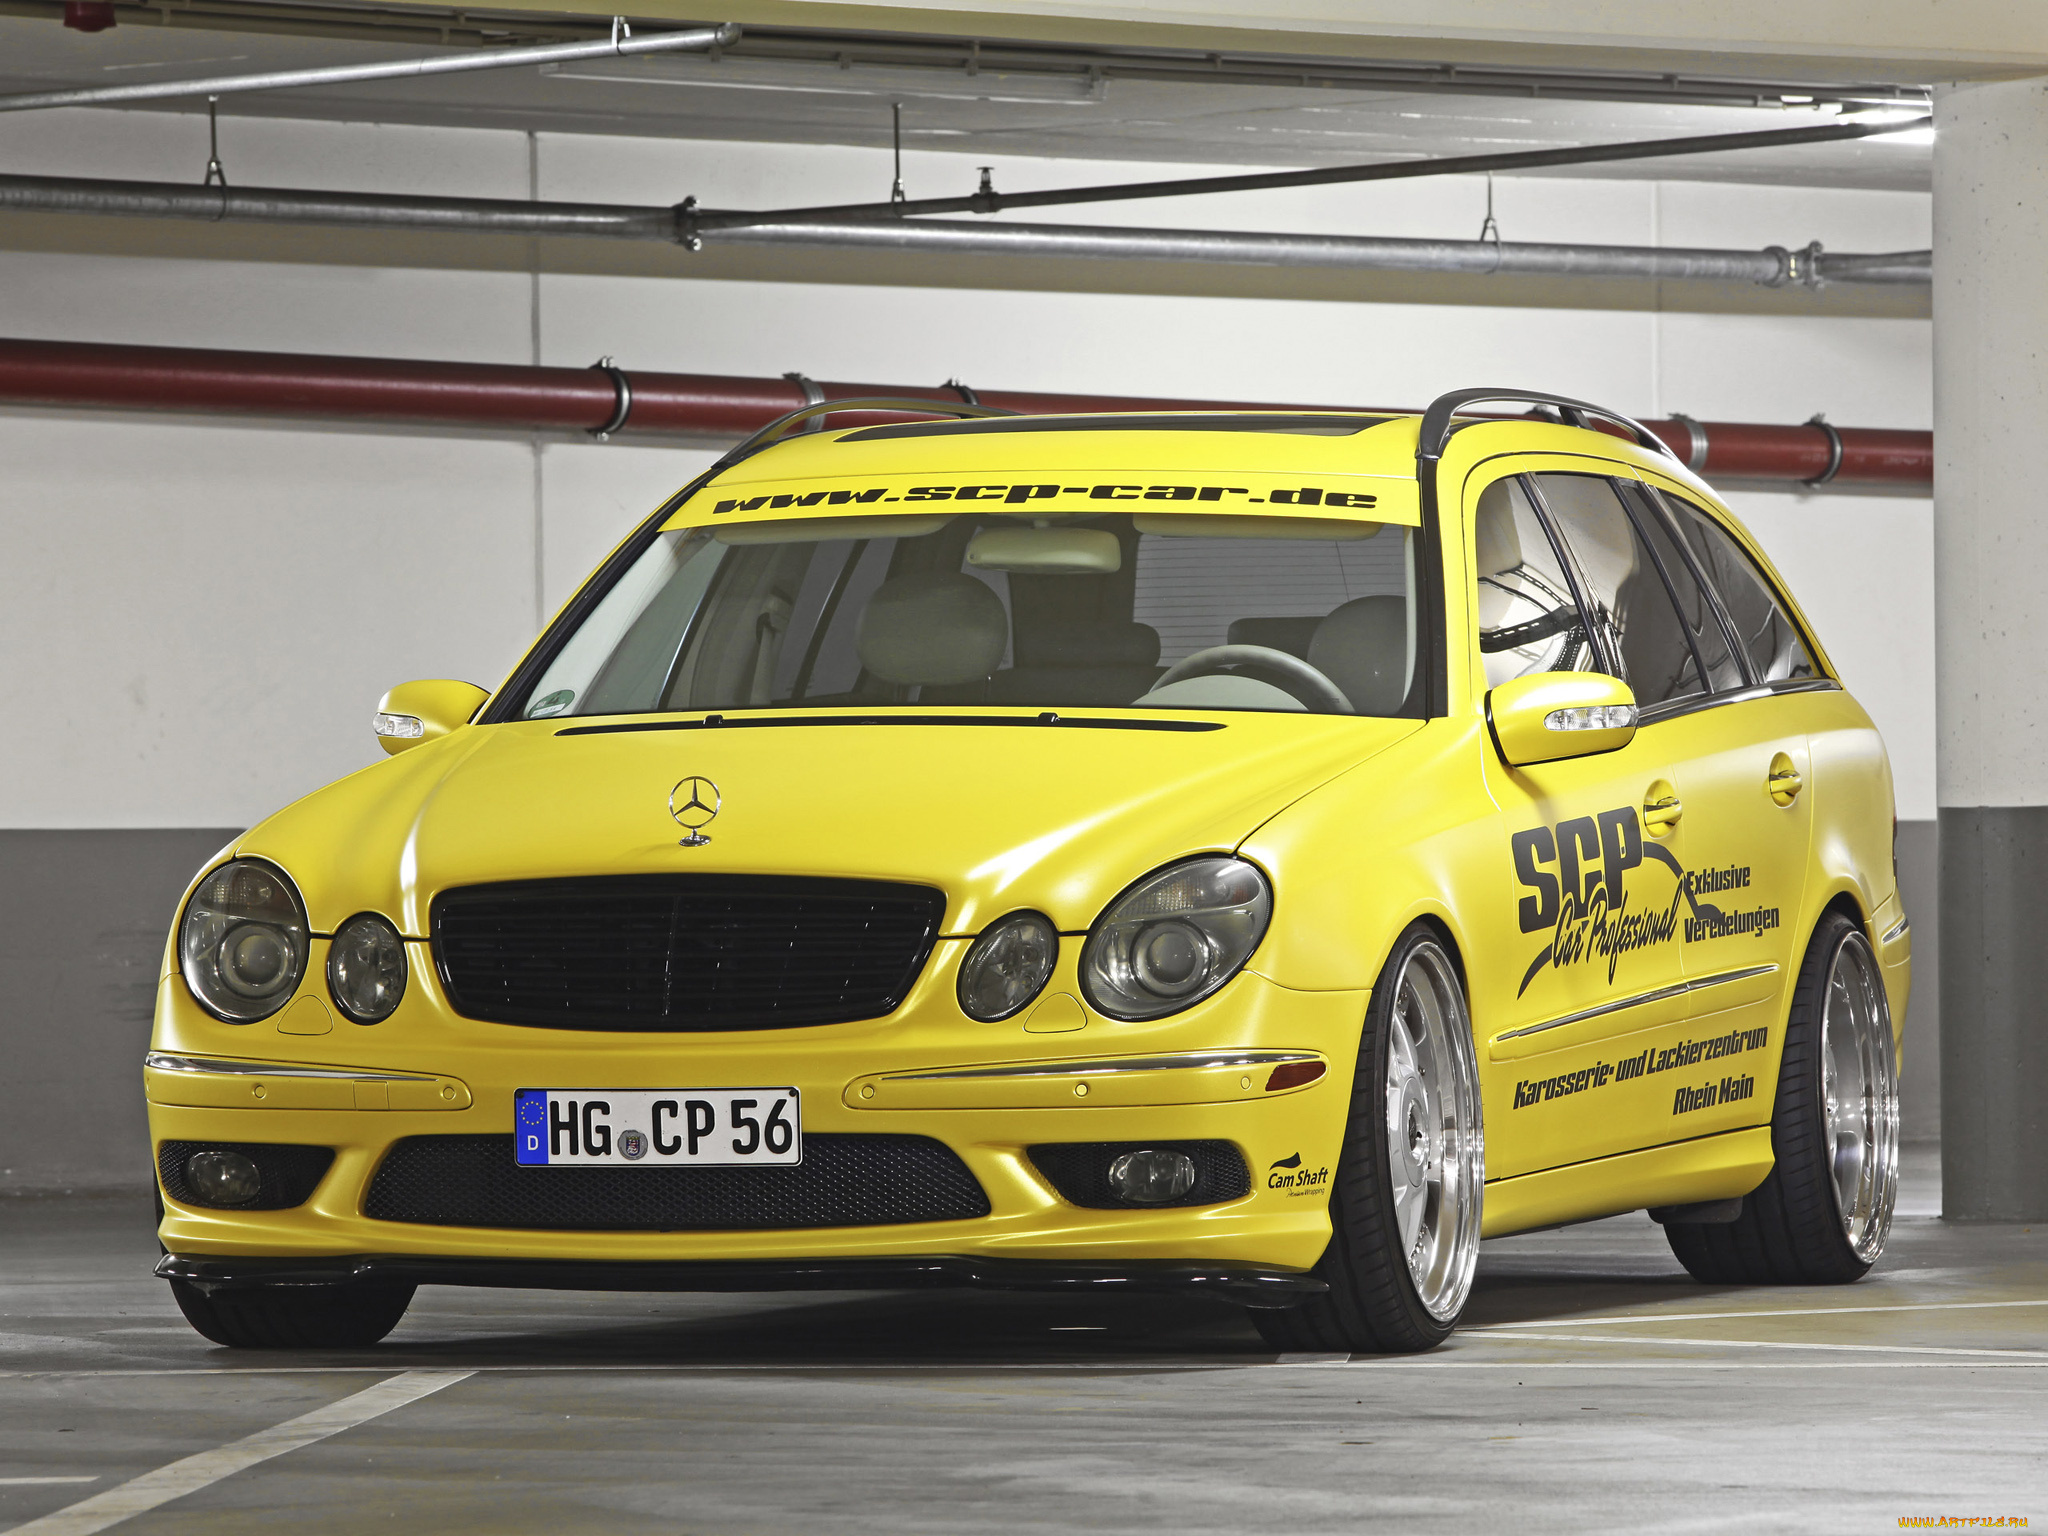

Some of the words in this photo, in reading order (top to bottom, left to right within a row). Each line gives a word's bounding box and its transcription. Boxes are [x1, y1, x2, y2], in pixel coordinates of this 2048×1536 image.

[713, 484, 1378, 514] www.scp-car.de
[1511, 805, 1643, 934] SCP
[1686, 864, 1751, 896] Exklusive
[1551, 898, 1585, 969] Car
[1586, 879, 1685, 986] Professional
[1684, 905, 1780, 944] Veredelungen
[1615, 1050, 1647, 1082] und
[1646, 1026, 1768, 1075] Lackierzentrum
[1672, 1082, 1718, 1115] Rhein
[1718, 1073, 1754, 1104] Main
[527, 1135, 539, 1151] D
[550, 1100, 611, 1156] HG
[652, 1099, 715, 1155] CP
[731, 1098, 793, 1155] 56
[1268, 1173, 1294, 1189] Cam
[1296, 1167, 1328, 1187] Shaft
